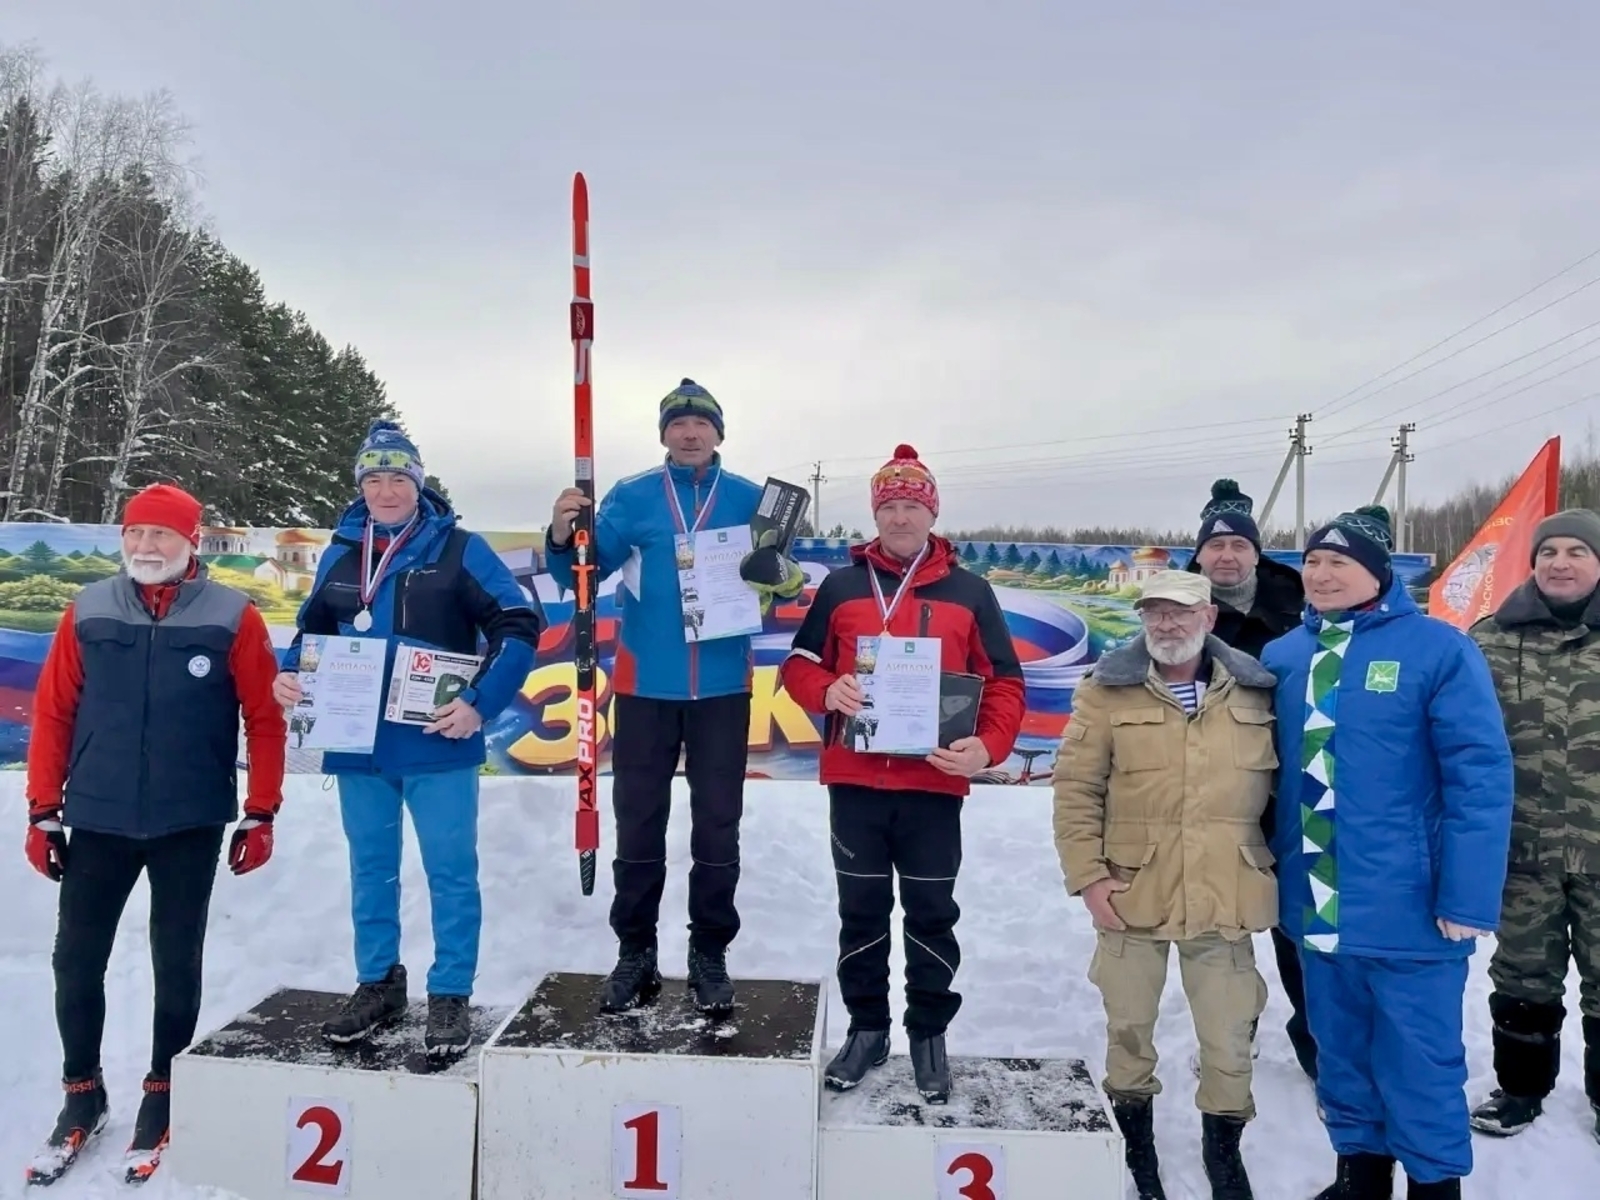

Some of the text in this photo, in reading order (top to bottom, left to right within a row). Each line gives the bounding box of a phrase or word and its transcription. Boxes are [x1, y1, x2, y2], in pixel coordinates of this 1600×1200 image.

[885, 662, 934, 674] ДИПЛОМ
[578, 697, 593, 764] PRO
[292, 1106, 344, 1185] 2
[623, 1110, 668, 1190] 1
[946, 1152, 996, 1200] 3
